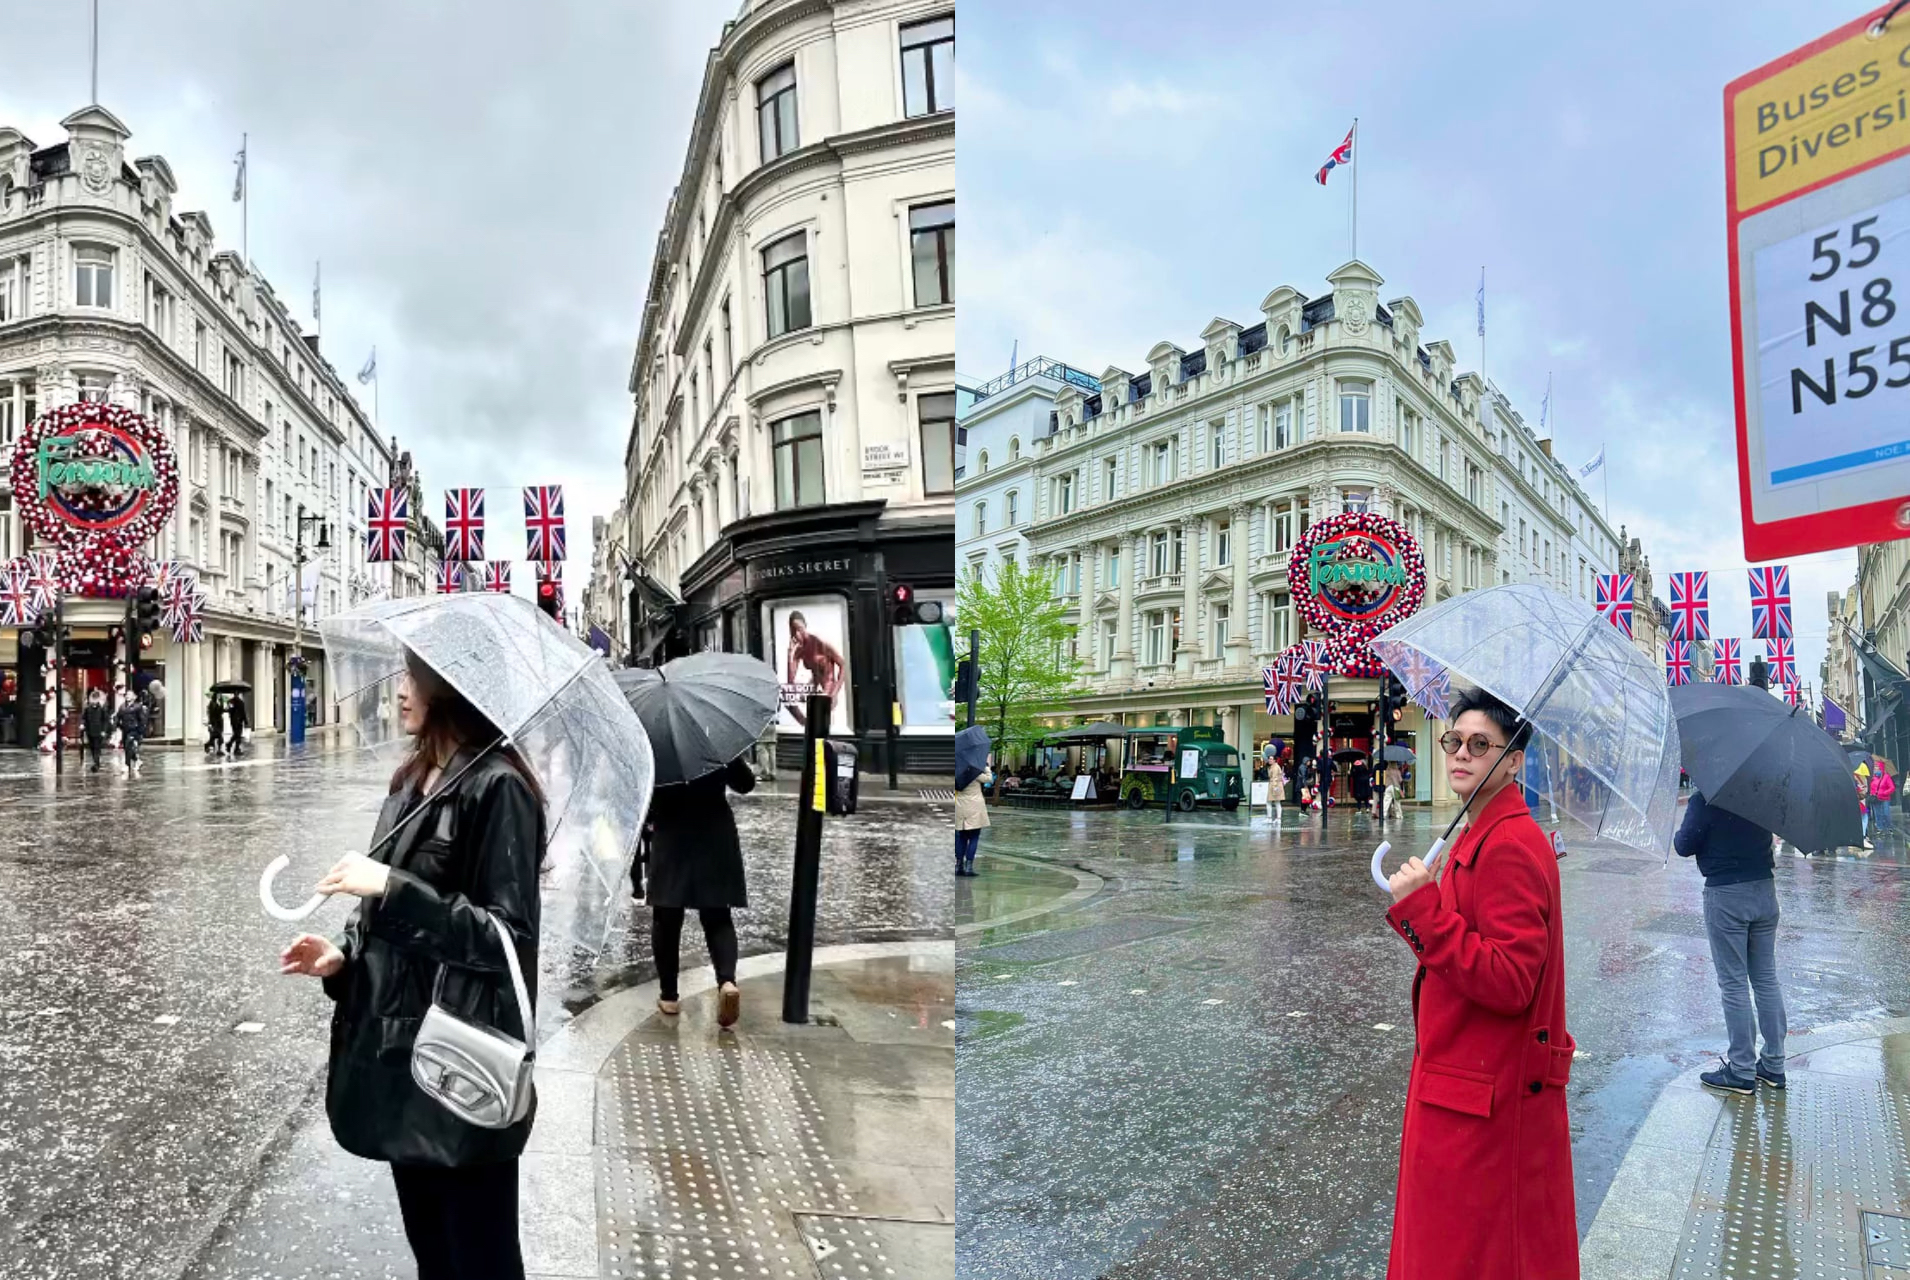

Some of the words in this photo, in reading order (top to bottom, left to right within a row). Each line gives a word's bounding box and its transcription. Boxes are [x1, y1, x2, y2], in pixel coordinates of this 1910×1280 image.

[1757, 60, 1881, 135] Buses
[1759, 89, 1907, 180] Diversi
[1808, 215, 1881, 282] 55
[1804, 277, 1897, 347] N8
[1790, 335, 1910, 415] N55
[34, 436, 155, 500] Fenwick
[797, 558, 851, 574] SECRET
[1307, 541, 1406, 597] Fenwick
